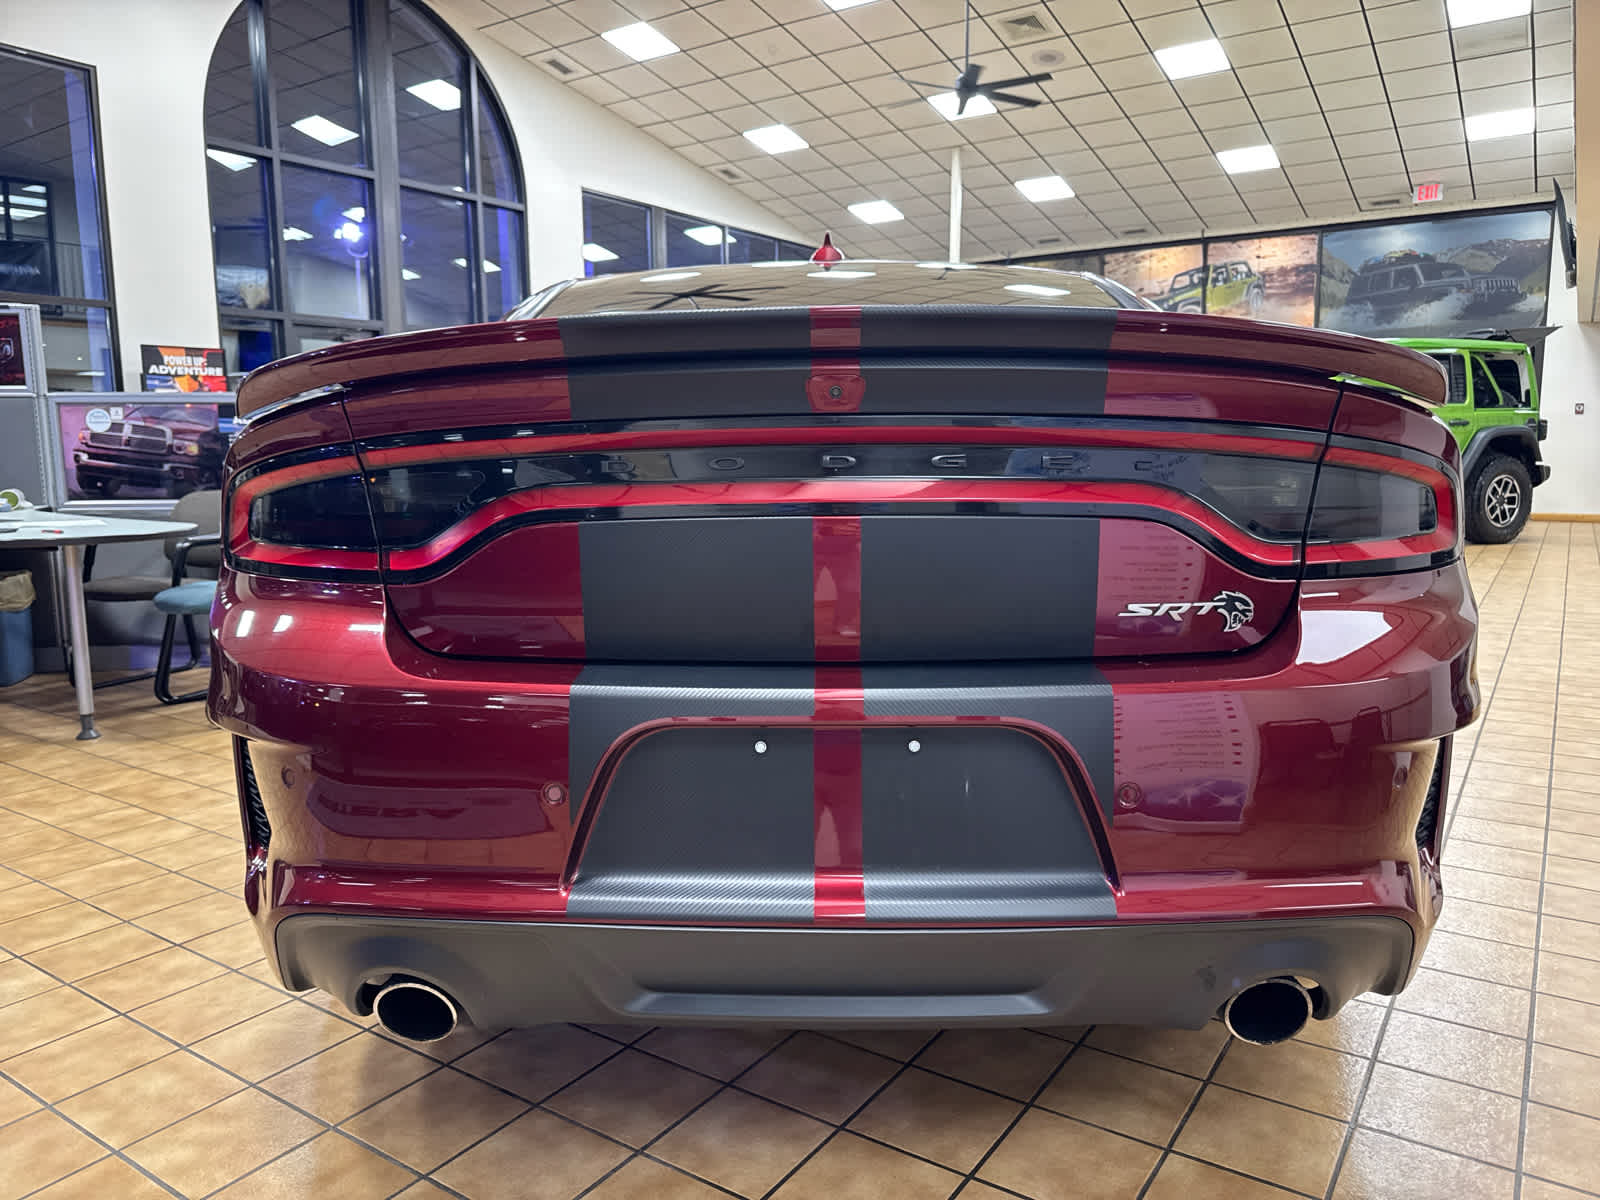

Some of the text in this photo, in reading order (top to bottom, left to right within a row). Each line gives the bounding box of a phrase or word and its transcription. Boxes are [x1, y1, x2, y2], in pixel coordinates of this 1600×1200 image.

[1417, 184, 1440, 201] EXIT
[163, 355, 192, 366] POWER
[148, 364, 224, 376] ADVENTURE
[1117, 602, 1226, 622] SRT
